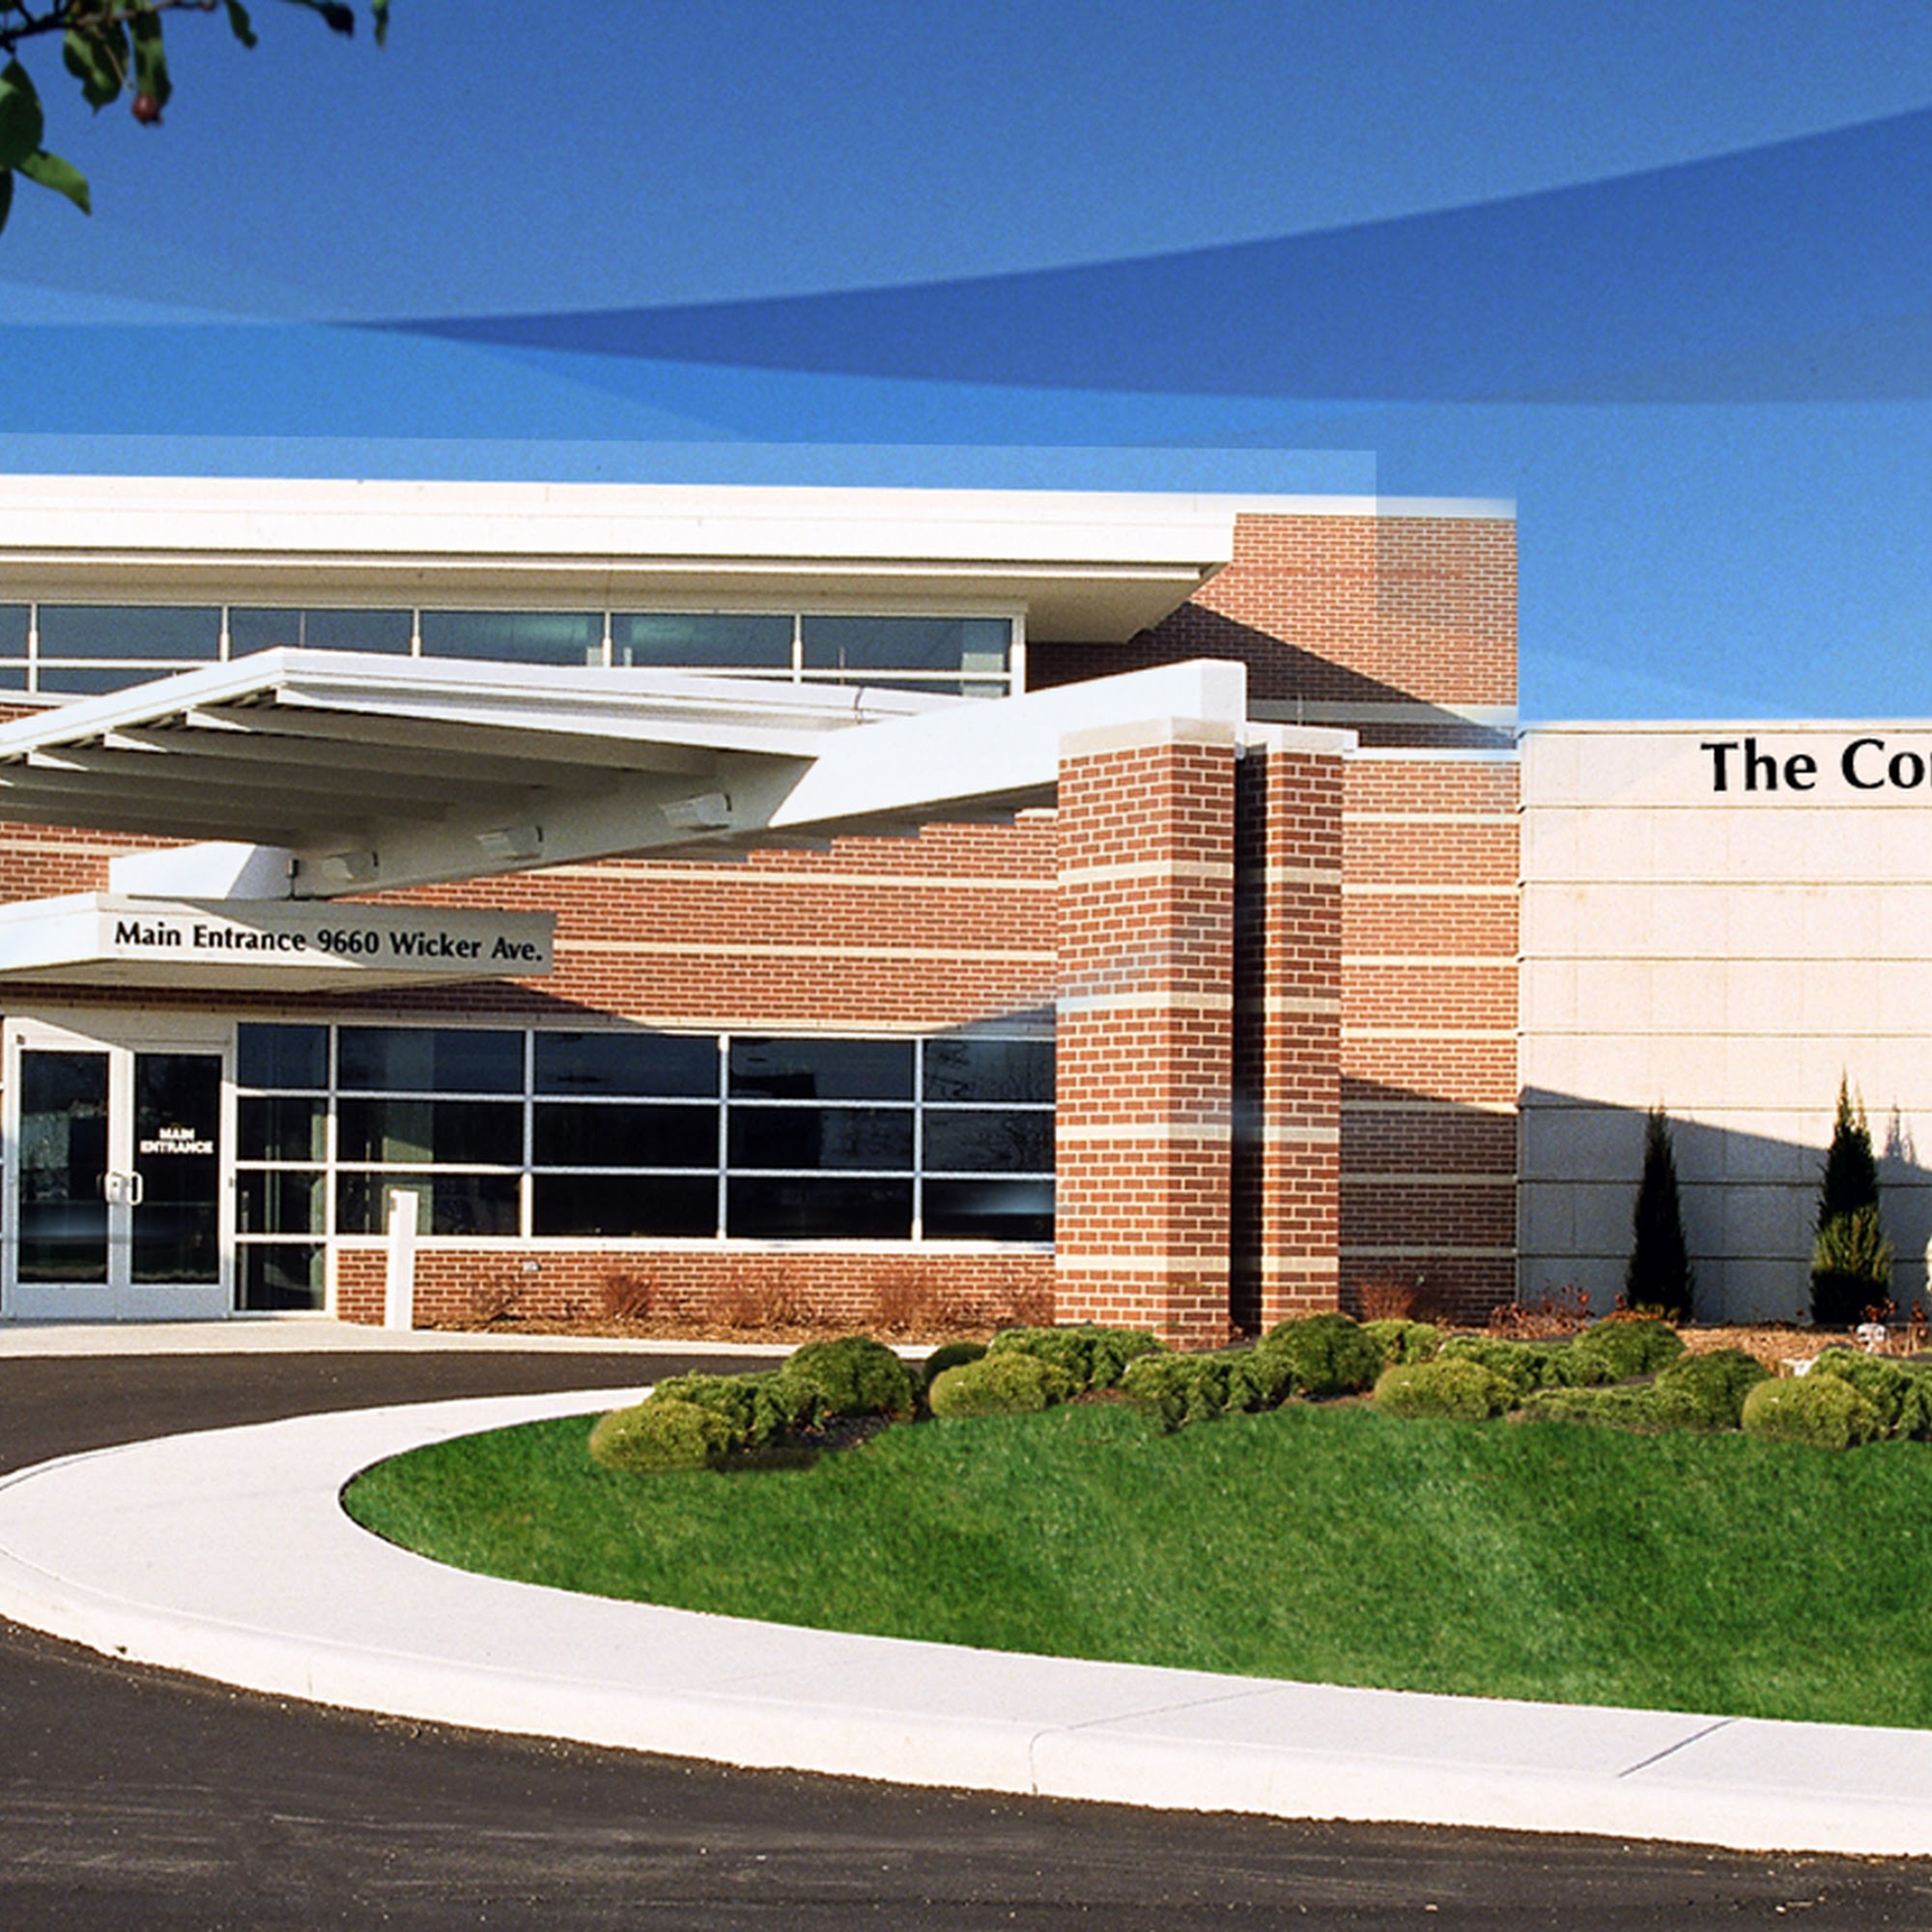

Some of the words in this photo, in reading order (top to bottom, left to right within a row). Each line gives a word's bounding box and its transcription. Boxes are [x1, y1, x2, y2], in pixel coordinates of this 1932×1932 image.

[1700, 738, 1817, 791] The
[1841, 738, 1932, 789] Co
[115, 921, 182, 947] Main
[193, 924, 306, 952] Entrance
[317, 929, 380, 954] 9660
[390, 932, 481, 958] Wicker
[491, 936, 544, 961] Ave.
[158, 1127, 195, 1139] MAIN
[140, 1141, 213, 1153] ENTRANCE
